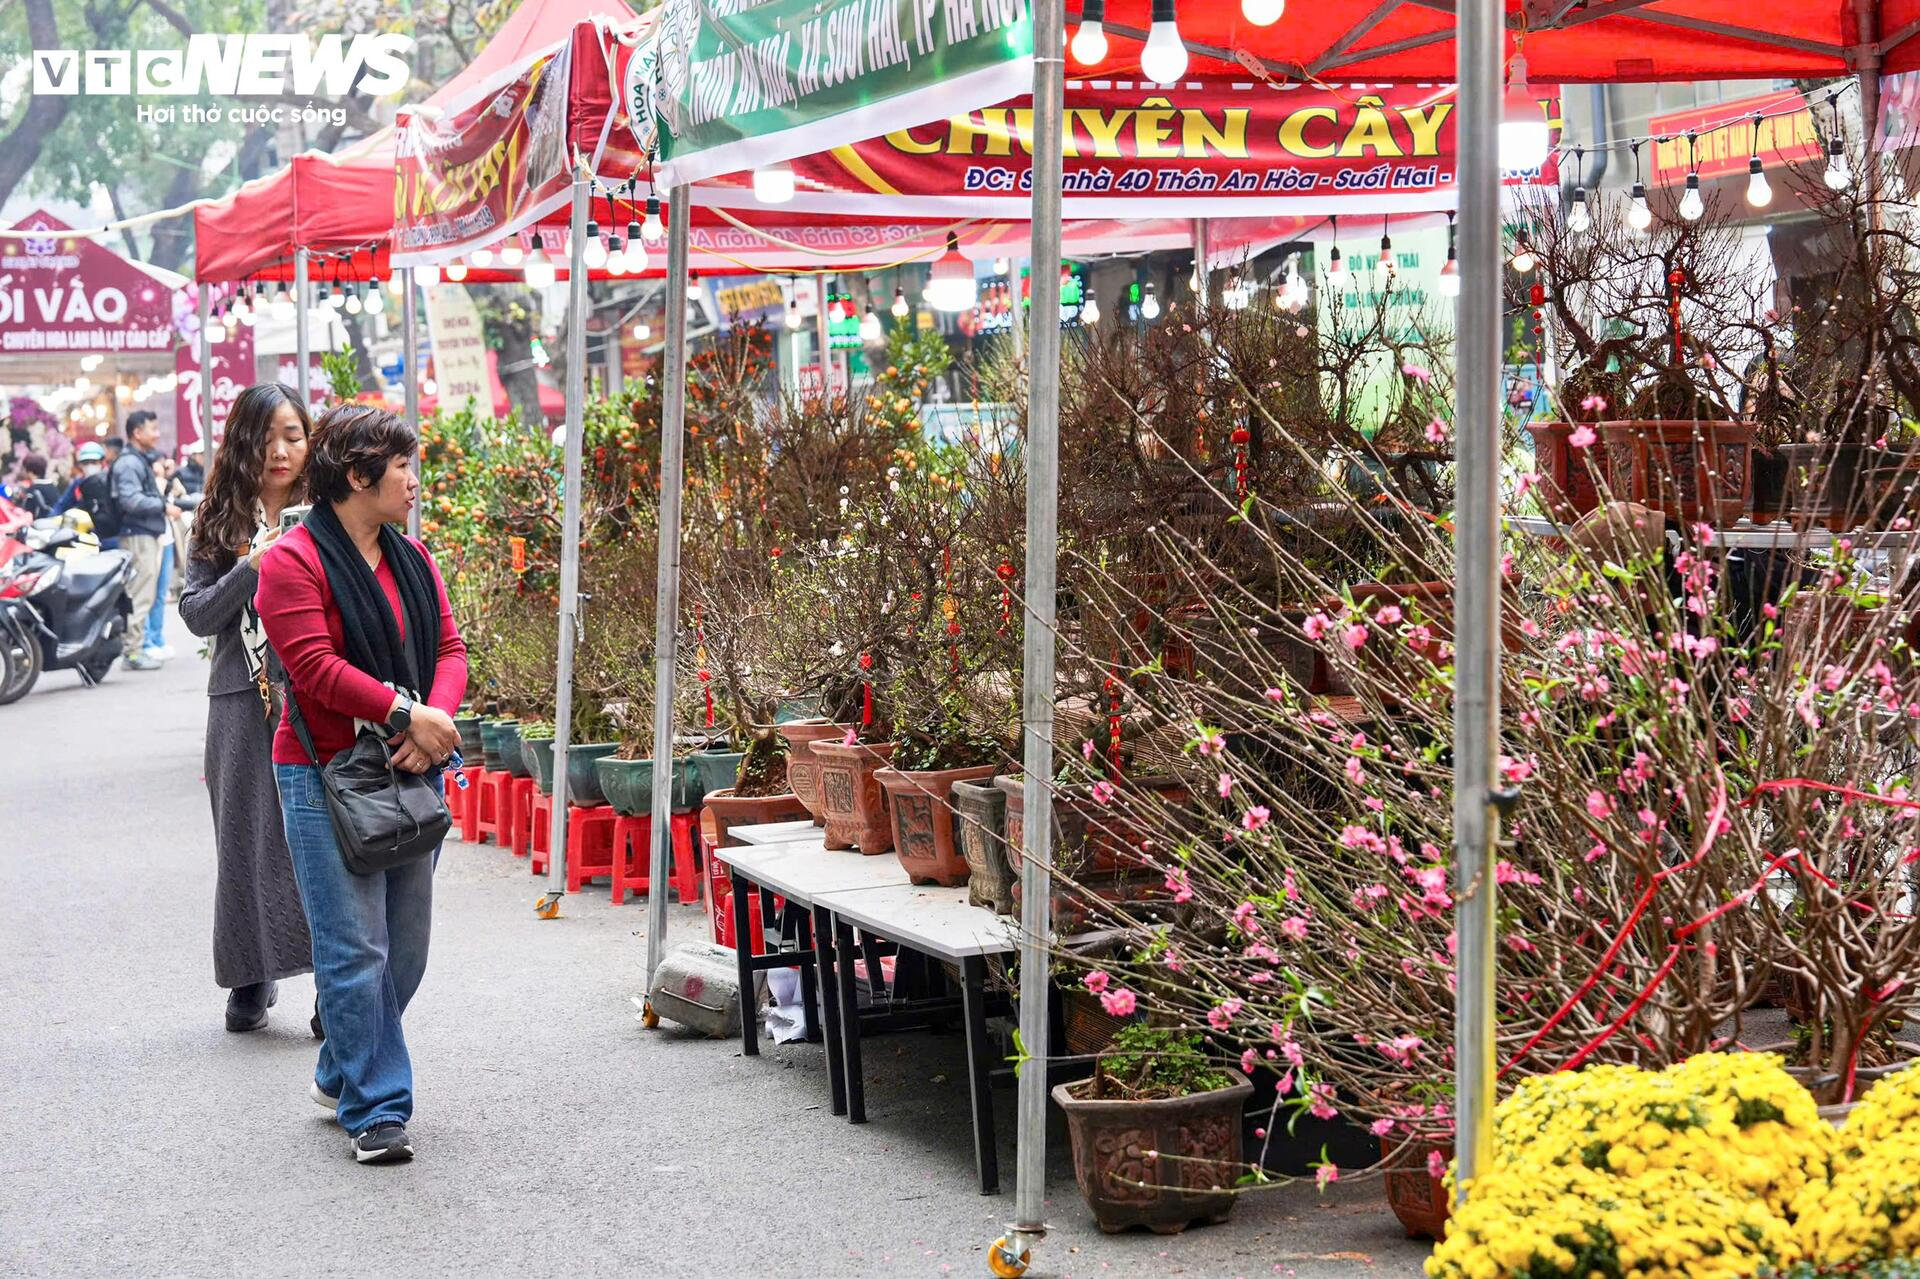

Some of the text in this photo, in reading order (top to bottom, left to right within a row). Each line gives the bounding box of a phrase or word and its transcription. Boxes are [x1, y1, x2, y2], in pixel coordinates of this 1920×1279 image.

[690, 41, 736, 126] THÔN
[730, 42, 761, 117] AN
[798, 2, 823, 97] XÃ
[867, 0, 912, 73] HAI,
[913, 0, 936, 56] TP
[633, 83, 648, 124] HOA
[1278, 95, 1455, 158] CÂY
[965, 166, 1015, 190] ĐC:
[1019, 167, 1032, 190] S
[1061, 166, 1113, 191] nhà
[1116, 168, 1151, 191] 40
[1157, 166, 1215, 191] Thôn
[1220, 168, 1258, 190] An
[1260, 164, 1317, 191] Hòa
[1334, 161, 1388, 189] Suối
[1393, 165, 1437, 188] Hai
